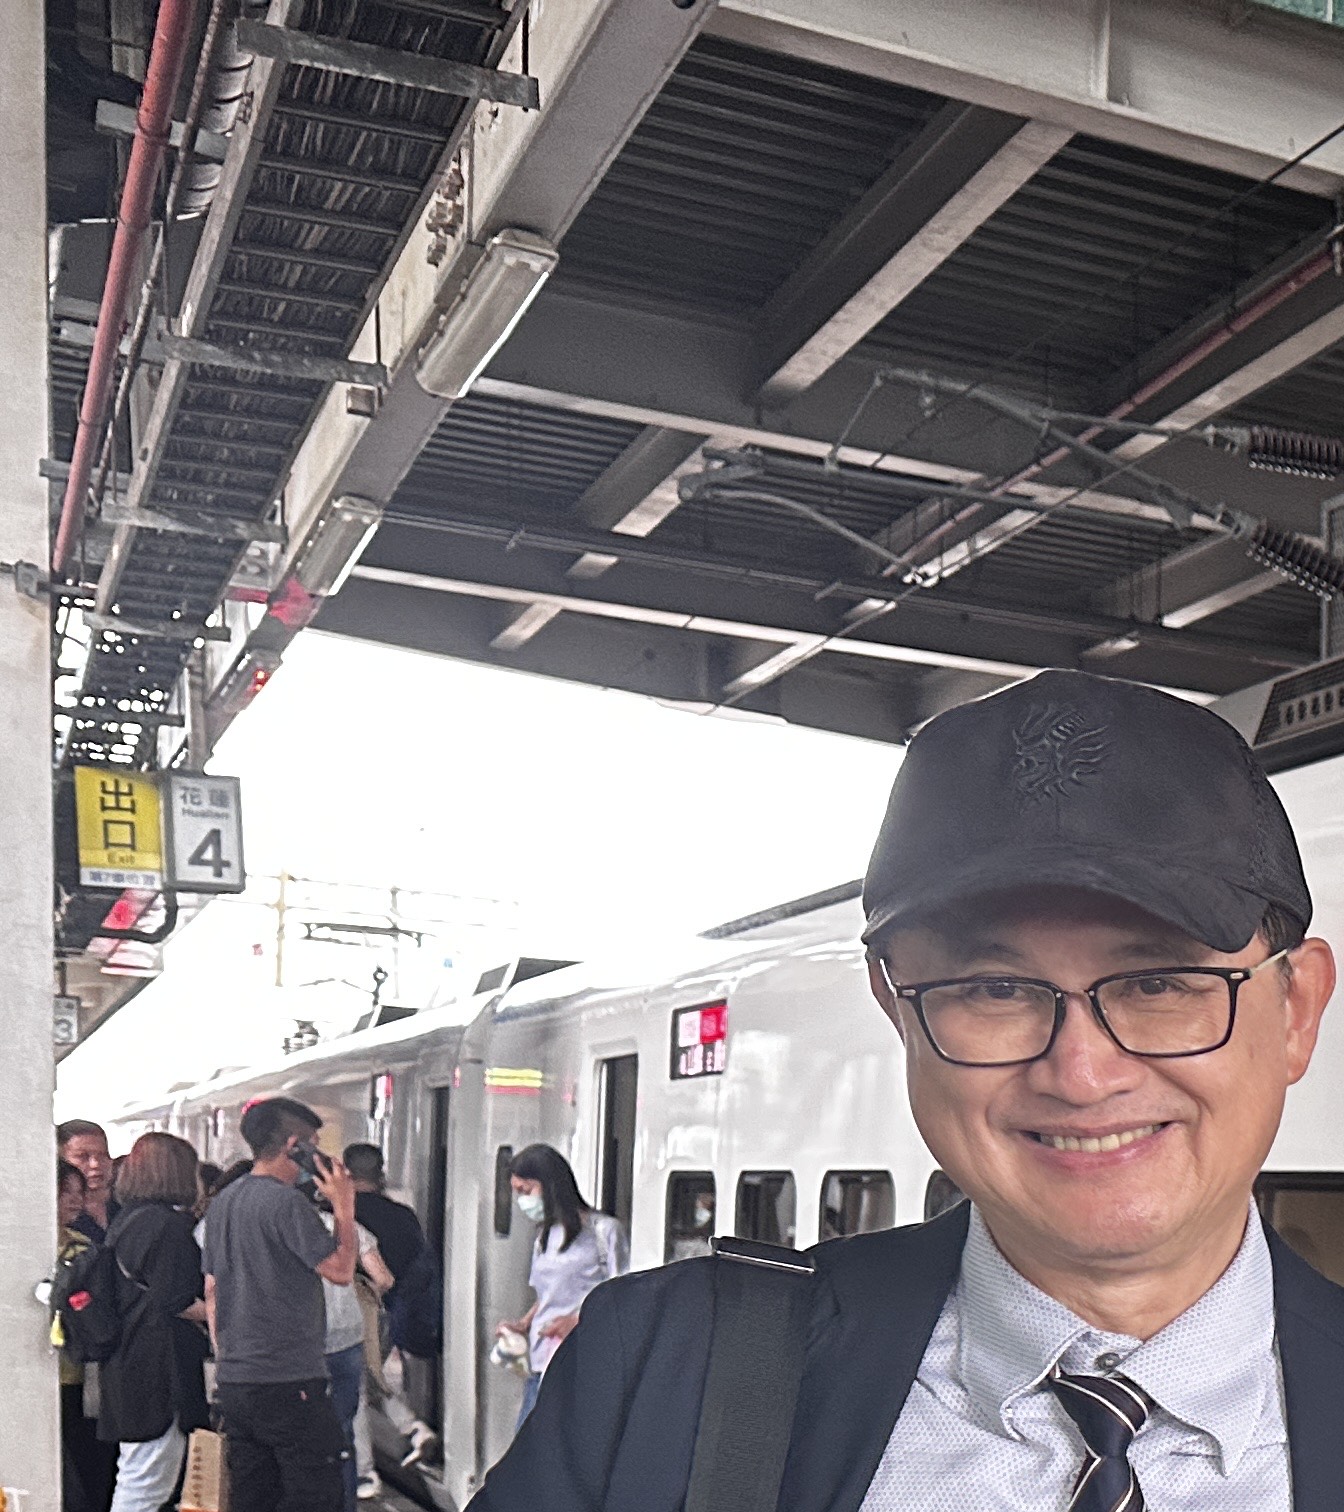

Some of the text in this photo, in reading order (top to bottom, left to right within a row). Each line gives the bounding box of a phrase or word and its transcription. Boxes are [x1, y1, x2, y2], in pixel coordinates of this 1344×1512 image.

[100, 778, 136, 851] 出口
[107, 852, 136, 865] Exit
[188, 828, 231, 878] 4
